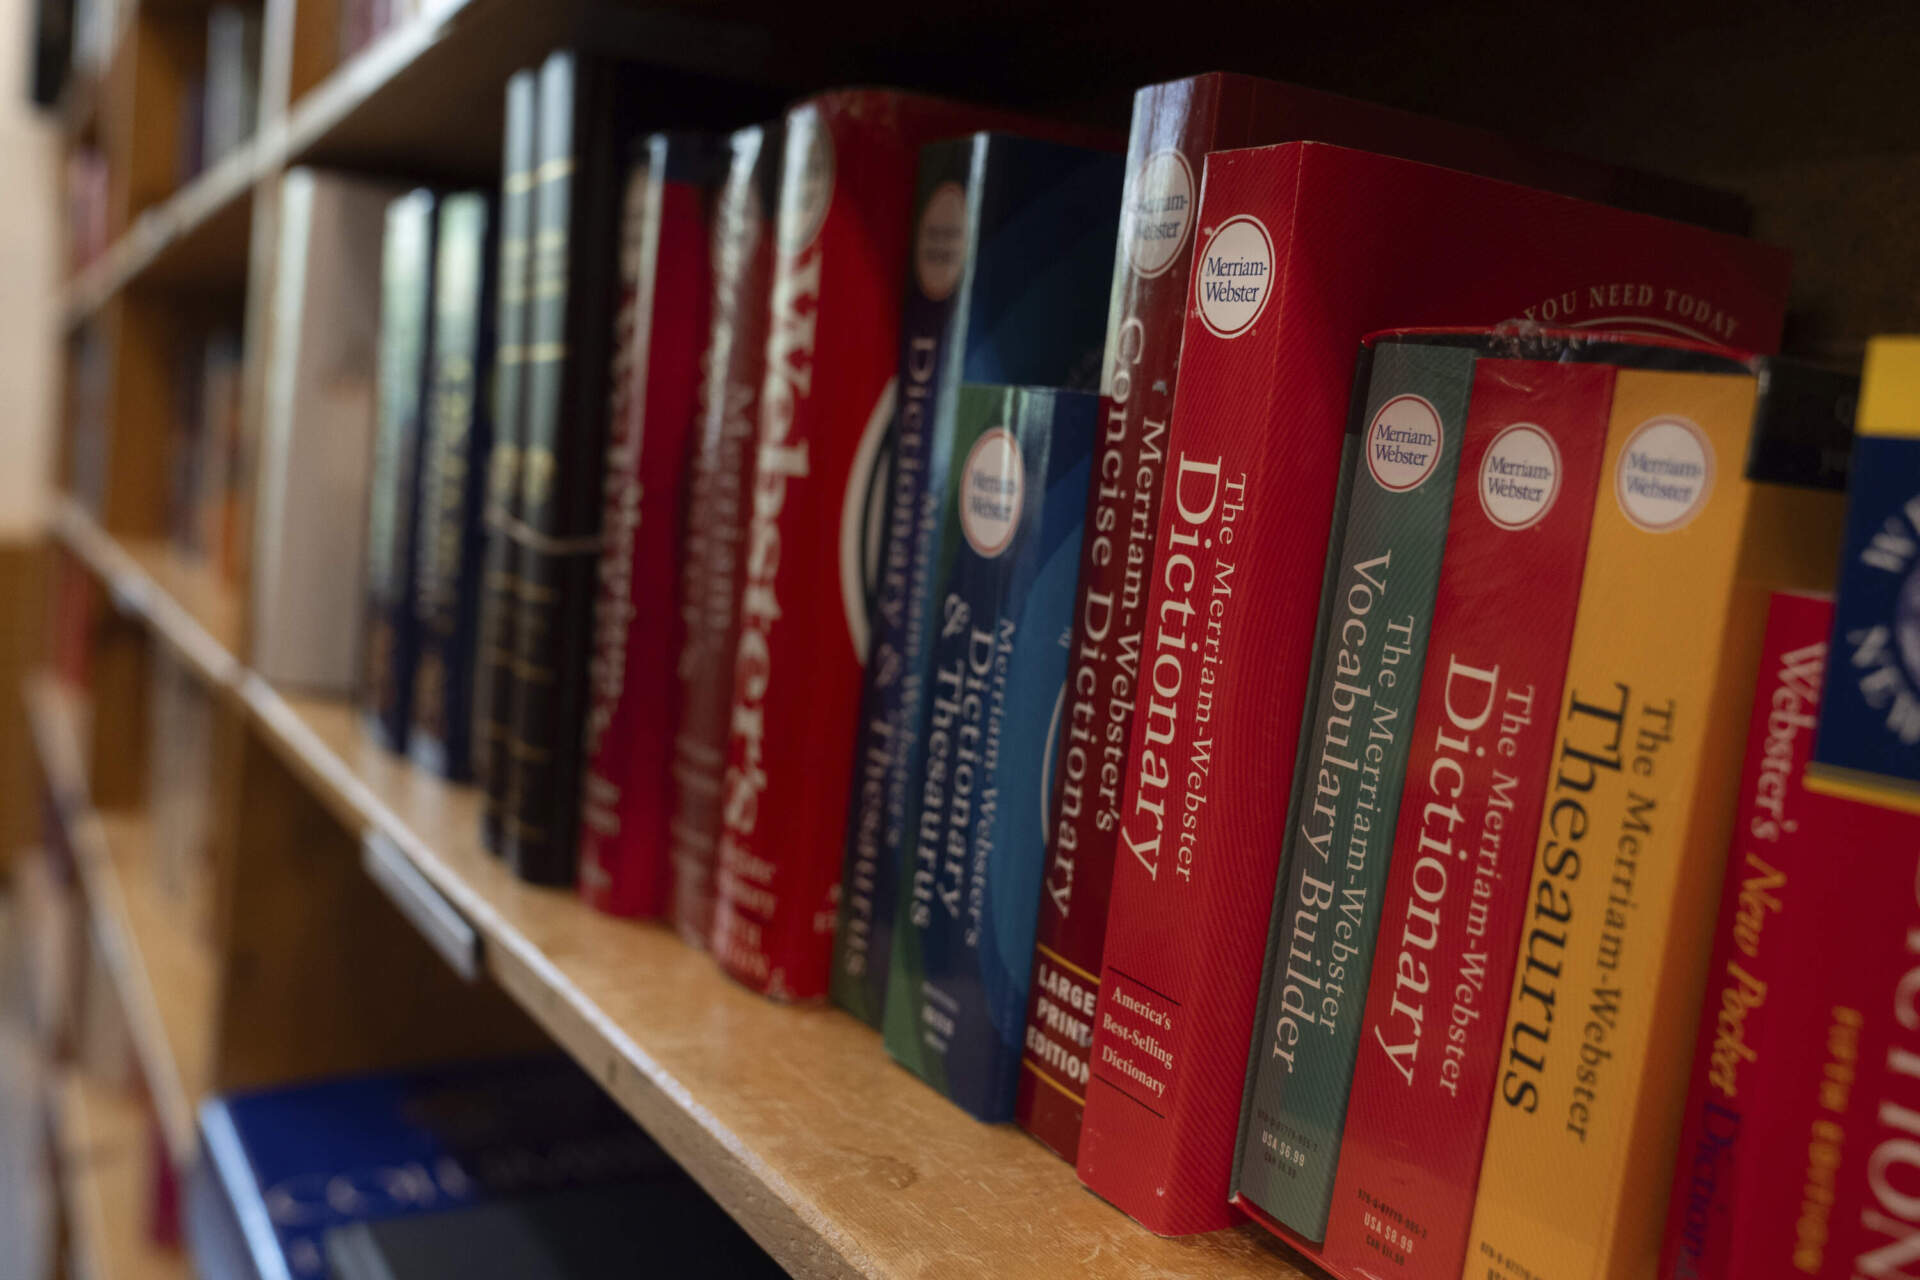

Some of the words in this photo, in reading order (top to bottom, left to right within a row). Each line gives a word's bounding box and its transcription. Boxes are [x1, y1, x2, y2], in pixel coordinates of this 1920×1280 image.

[1205, 256, 1268, 277] Merriam-
[1205, 282, 1260, 302] Webster
[1523, 291, 1577, 323] YOU
[1589, 283, 1654, 309] NEED
[1663, 287, 1740, 340] TODAY
[1091, 316, 1146, 568] Concise
[1375, 444, 1429, 467] Webster
[1376, 424, 1437, 447] Merriam-
[1488, 456, 1552, 480] Merriam-
[1629, 452, 1701, 478] Merriam-
[1218, 473, 1247, 545] The
[1487, 477, 1544, 502] Webster
[1627, 476, 1693, 503] Webster
[723, 250, 823, 835] Webster's
[942, 593, 971, 638] &
[1096, 416, 1166, 833] Merriam-Webster's
[1377, 615, 1415, 689] The
[1121, 450, 1222, 881] Dictionary
[1175, 558, 1236, 882] Merriam-Webster
[1302, 549, 1392, 864] Vocabulary
[1498, 684, 1536, 758] The
[1626, 697, 1676, 779] The
[1751, 640, 1828, 846] Webster's
[937, 628, 995, 921] Dictionary
[1046, 591, 1114, 918] Dictionary
[910, 663, 966, 928] Thesaurus
[1319, 700, 1399, 1036] Merriam-Webster
[1374, 653, 1500, 1087] Dictionary
[1501, 681, 1631, 1116] Thesaurus
[1733, 852, 1788, 957] New
[1438, 767, 1520, 1098] Merriam-Webster
[1565, 790, 1659, 1146] Merriam-Webster
[1038, 963, 1097, 1017] LARGE
[1111, 986, 1172, 1030] America's
[1272, 869, 1335, 1074] Builder
[1026, 1025, 1090, 1084] EDITION
[1036, 997, 1091, 1047] PRINT
[1103, 1012, 1173, 1070] Best-Selling
[1102, 1045, 1165, 1098] Dictionary
[1262, 1130, 1279, 1150] USA
[1280, 1141, 1305, 1167] $6.99
[1364, 1212, 1382, 1234] USA
[1384, 1225, 1413, 1254] $8.99
